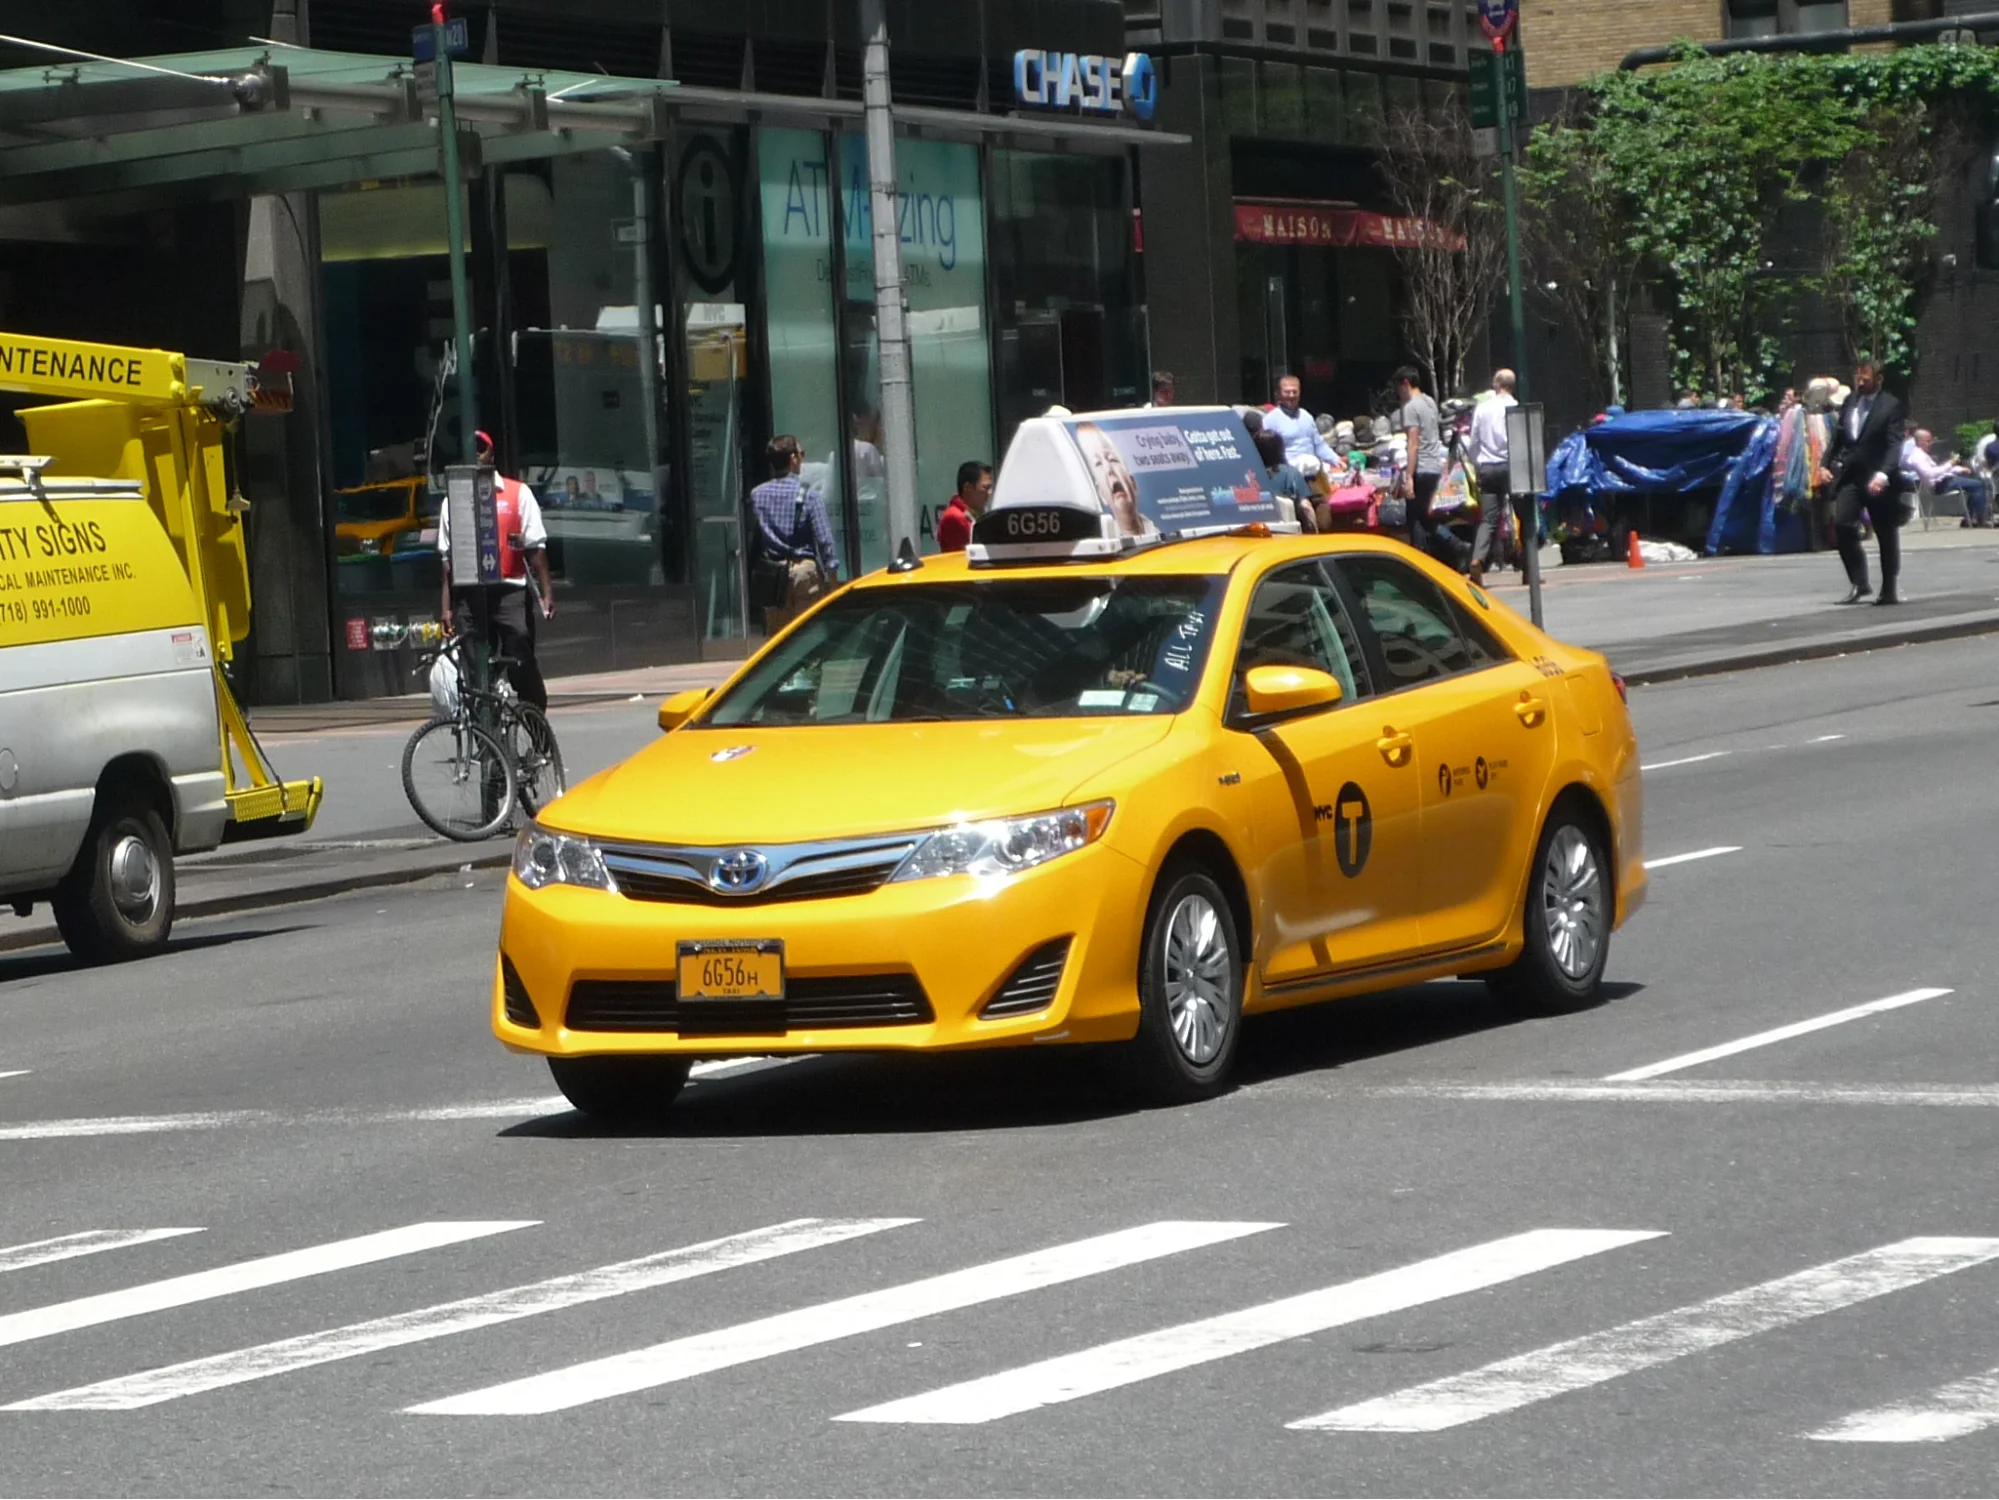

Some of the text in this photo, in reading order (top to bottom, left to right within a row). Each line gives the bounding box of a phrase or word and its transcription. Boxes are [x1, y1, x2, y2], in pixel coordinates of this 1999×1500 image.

[1014, 49, 1123, 111] CHASE
[1262, 213, 1332, 240] MAISON
[1135, 433, 1164, 449] Crying
[1133, 454, 1150, 467] two
[1150, 453, 1171, 466] seats
[1007, 512, 1061, 536] 6G56
[36, 520, 106, 557] SIGNS
[25, 564, 110, 588] MAINTENANCE
[112, 561, 137, 581] INC.
[0, 595, 91, 626] 718) 991-1000
[1164, 644, 1193, 672] ALL
[1313, 803, 1333, 822] NYC
[1341, 801, 1364, 865] T
